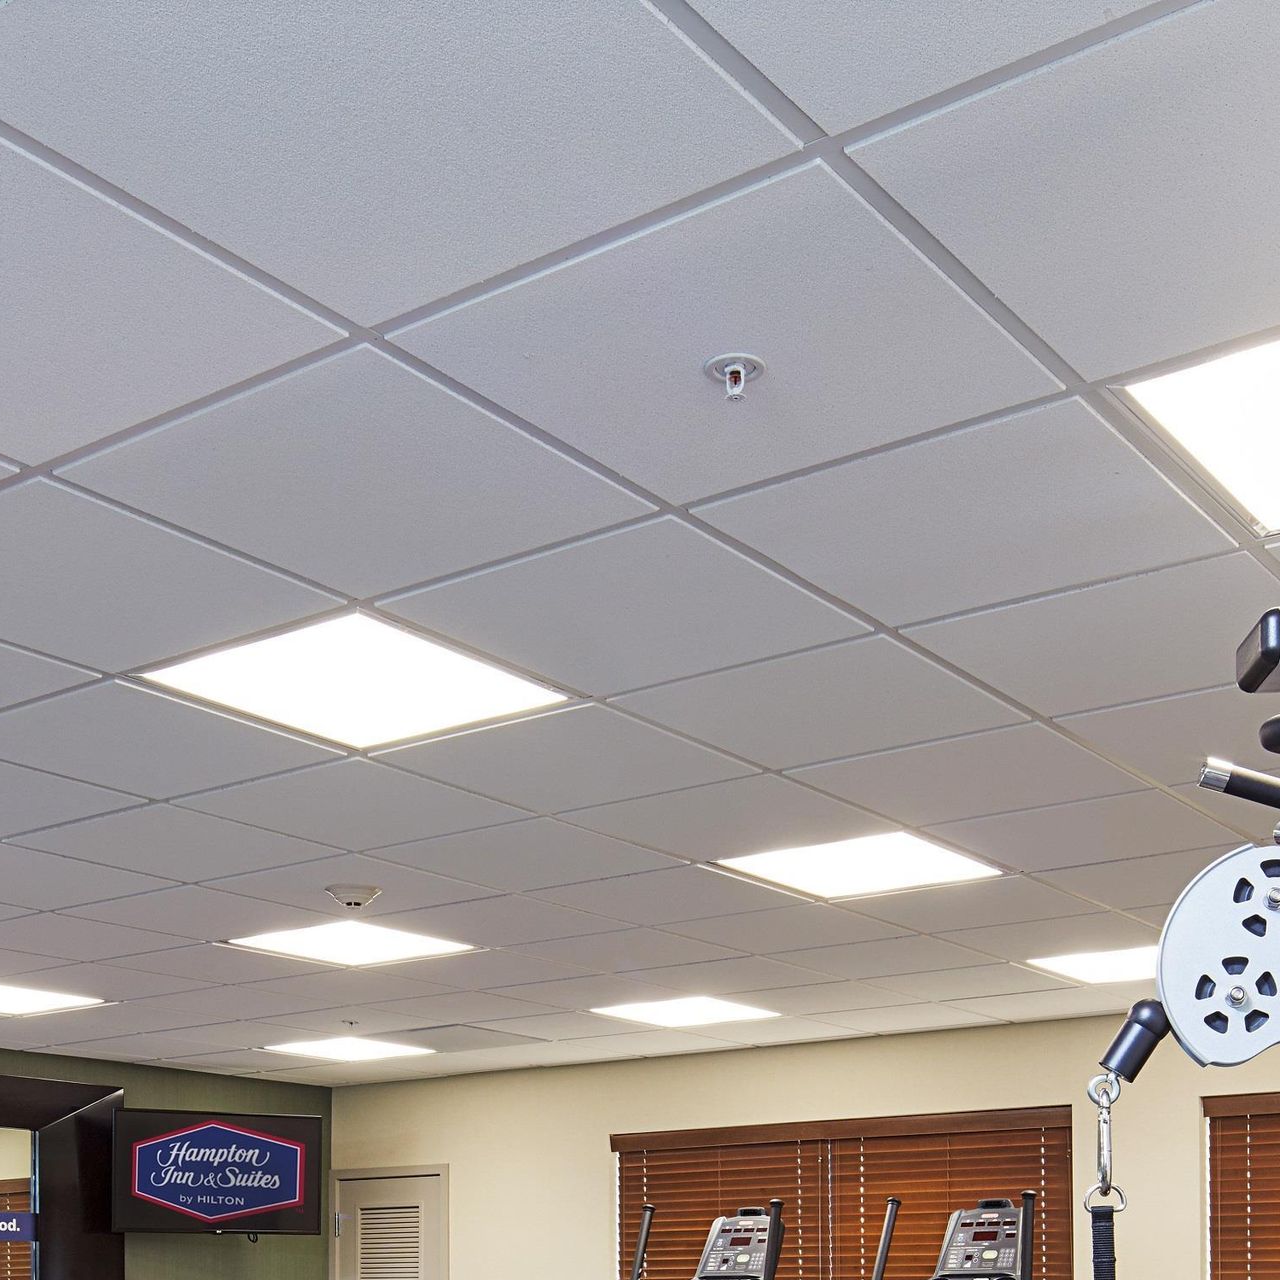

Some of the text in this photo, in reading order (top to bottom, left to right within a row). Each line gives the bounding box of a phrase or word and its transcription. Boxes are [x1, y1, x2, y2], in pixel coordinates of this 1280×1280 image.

[157, 1141, 269, 1167] Hampton
[150, 1165, 280, 1189] Inn & Suites
[179, 1194, 245, 1206] by HILTON
